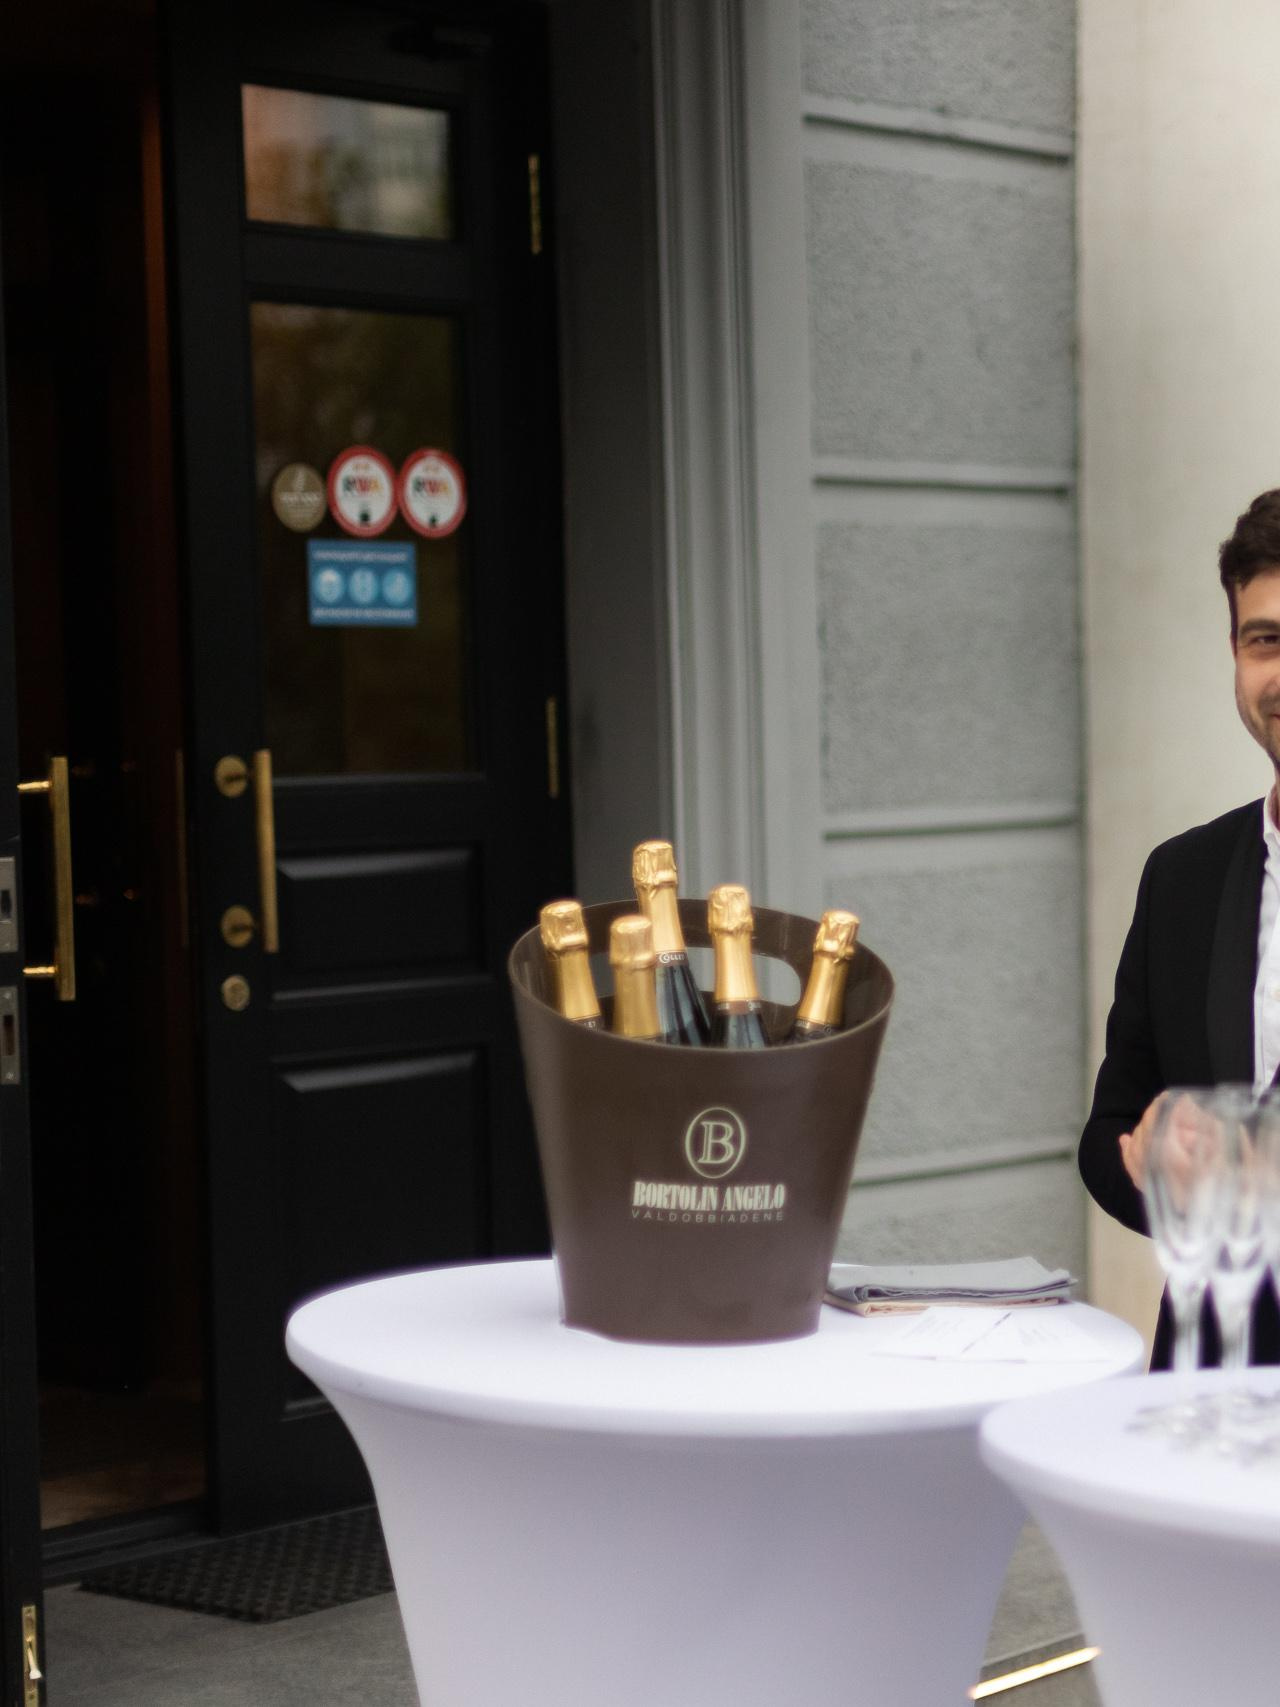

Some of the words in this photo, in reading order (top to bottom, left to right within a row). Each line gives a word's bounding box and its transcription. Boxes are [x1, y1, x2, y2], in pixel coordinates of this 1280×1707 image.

[698, 1121, 734, 1164] B
[633, 1180, 718, 1211] BORTOLIN
[722, 1183, 785, 1211] ANGELO
[632, 1210, 784, 1224] VALDOBBIADENE
